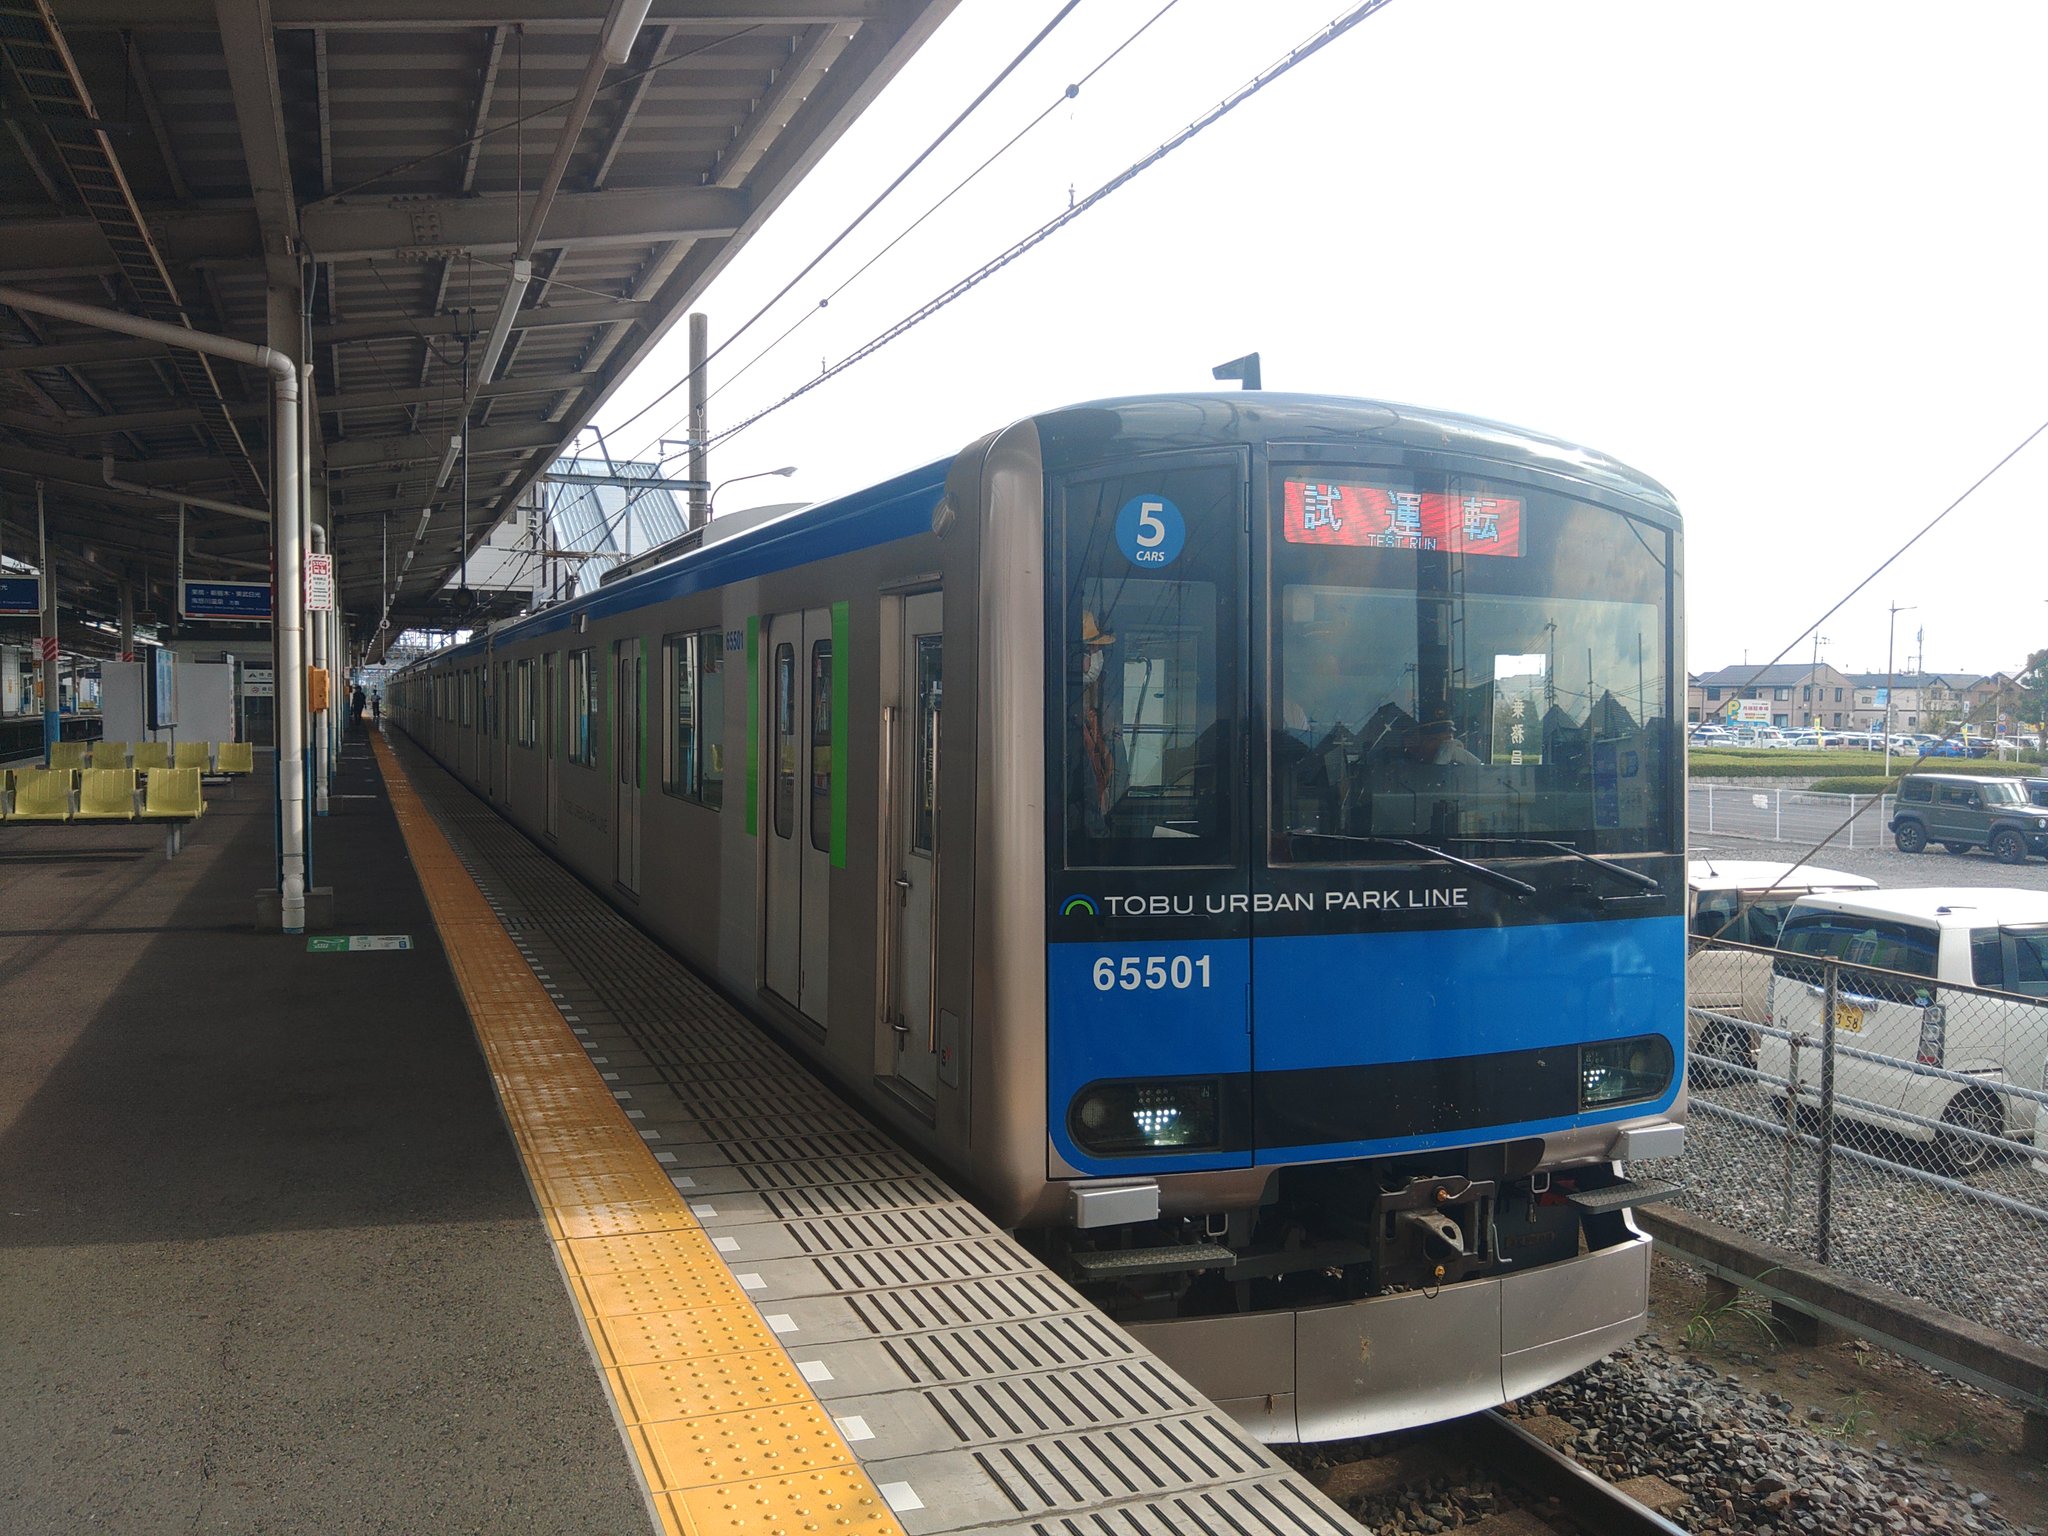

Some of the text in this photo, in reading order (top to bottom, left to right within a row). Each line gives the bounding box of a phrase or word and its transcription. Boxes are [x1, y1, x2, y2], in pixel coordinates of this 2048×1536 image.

[1136, 502, 1166, 548] 5
[1304, 485, 1499, 542] 試運転
[1136, 551, 1165, 562] CARS
[1367, 534, 1438, 550] TEST RUN
[1104, 888, 1468, 915] TOBU URBAN PARK LINE
[1093, 955, 1210, 991] 65501
